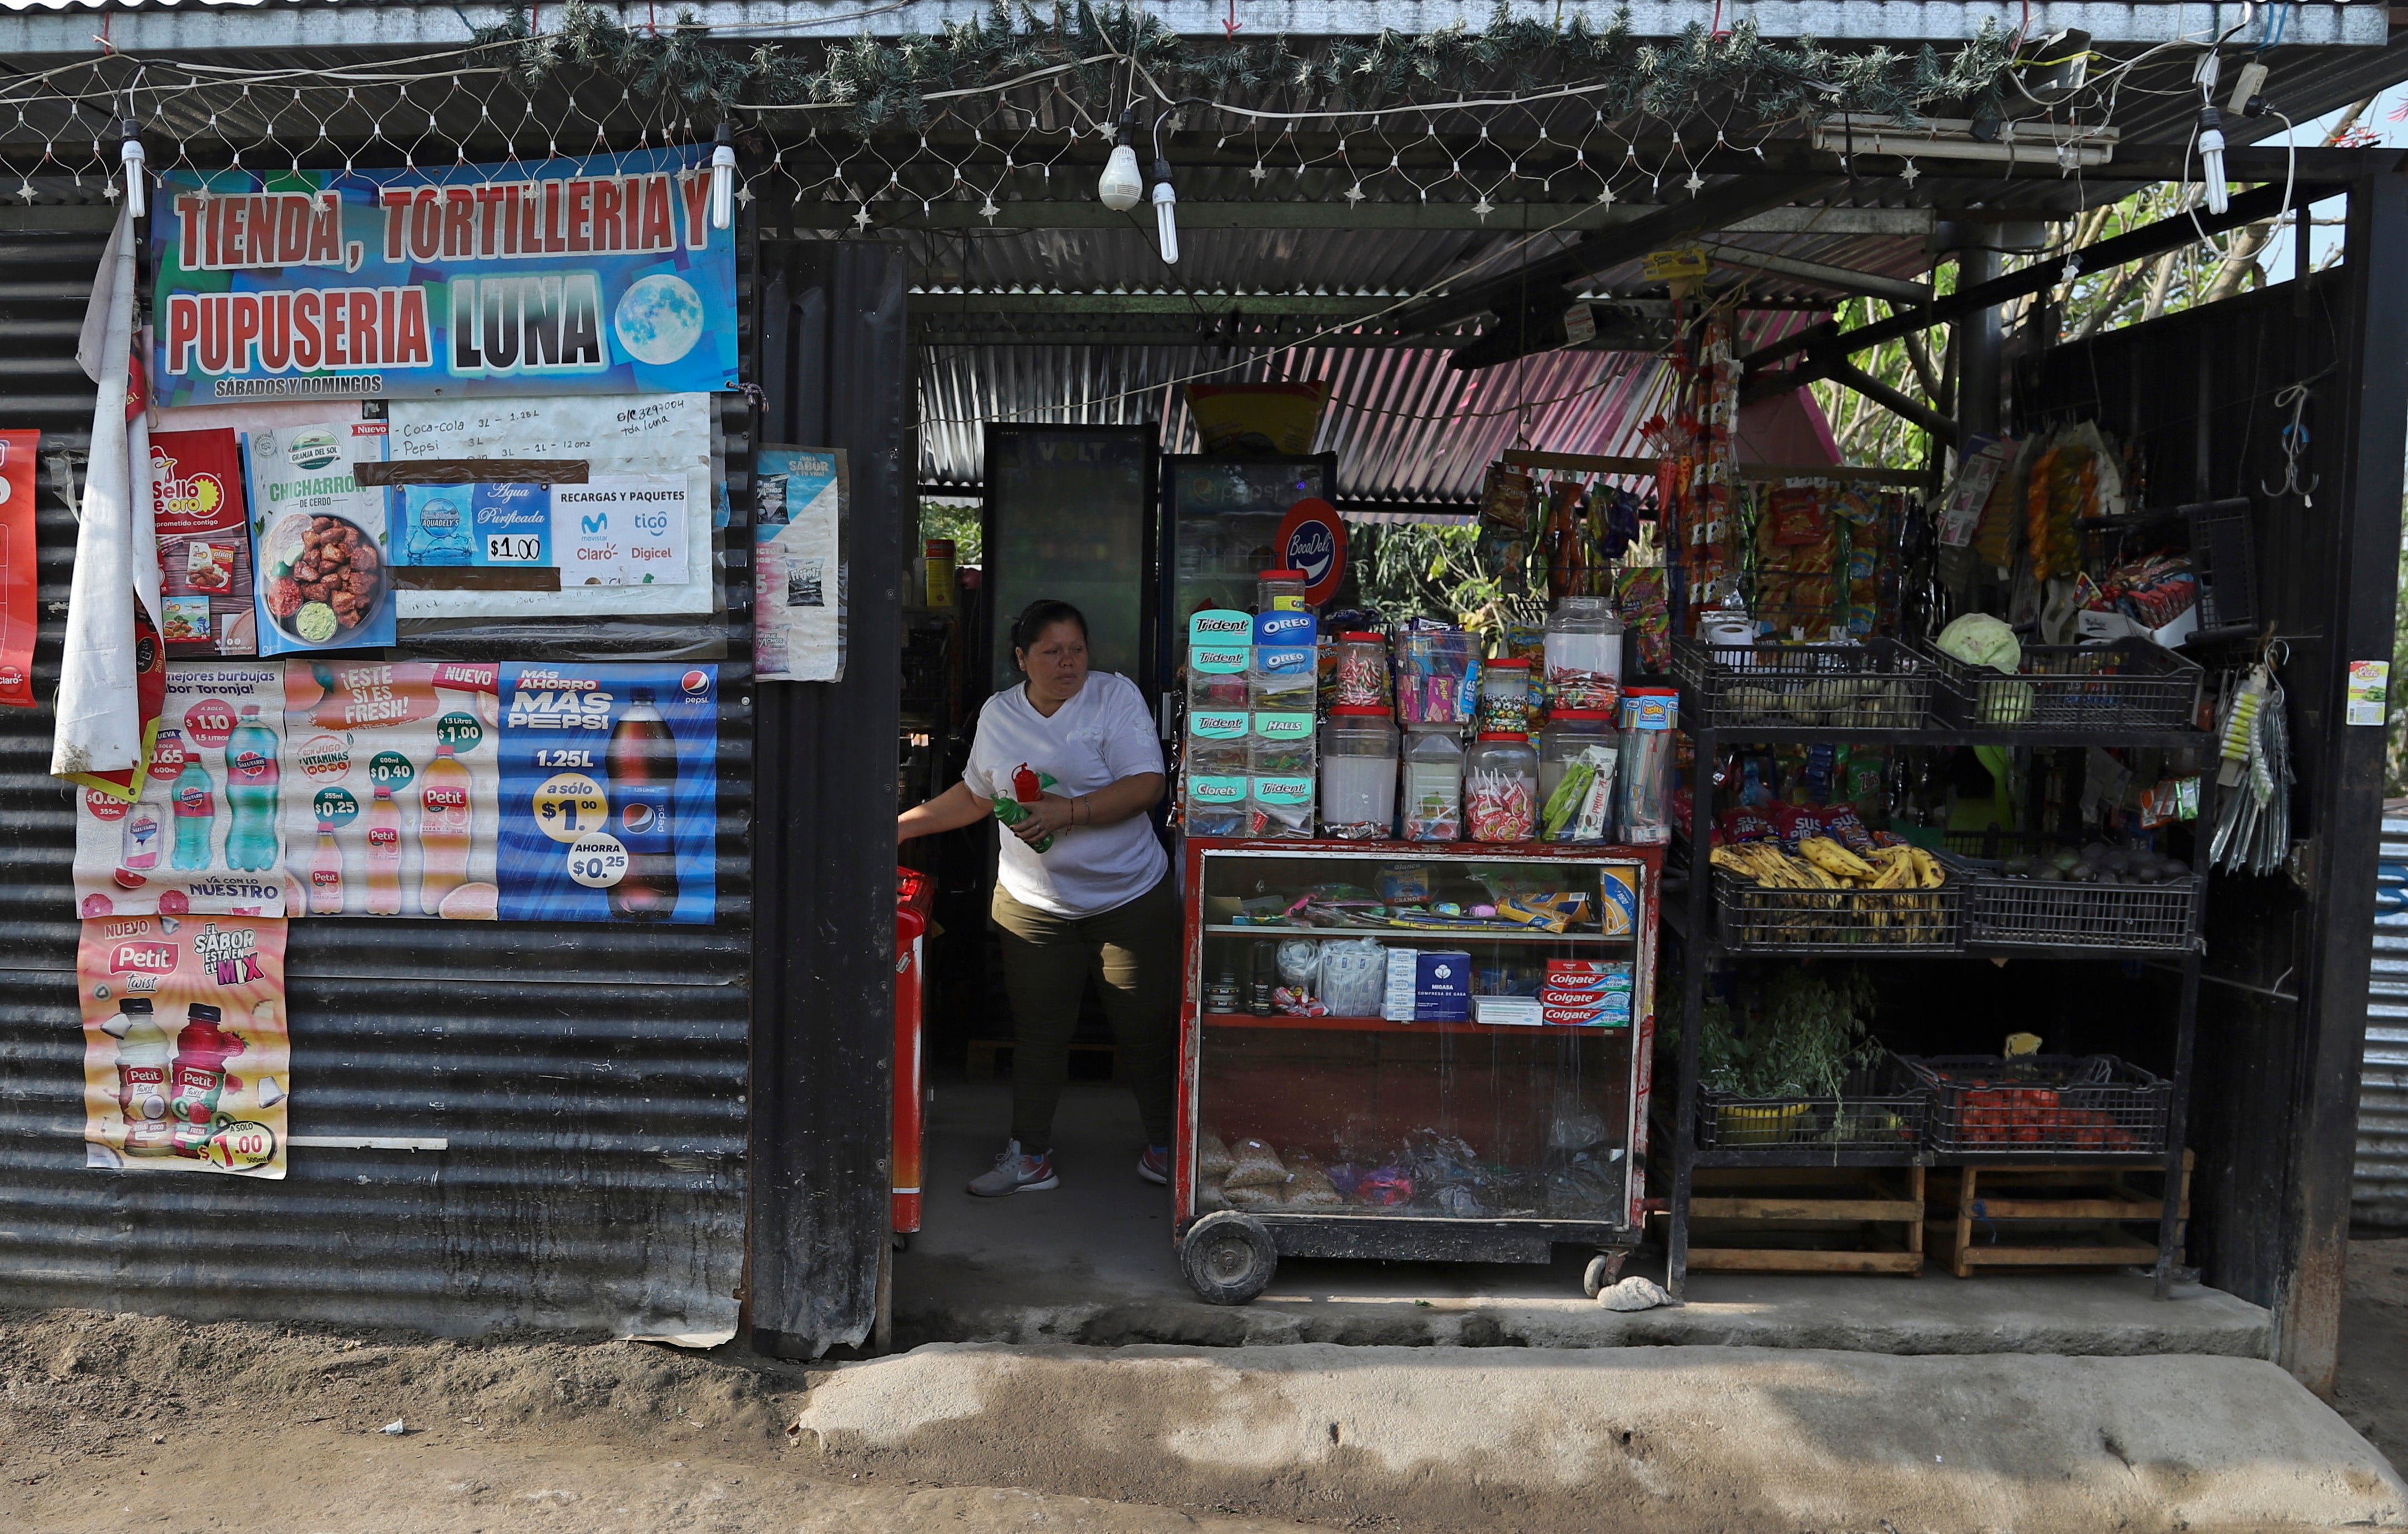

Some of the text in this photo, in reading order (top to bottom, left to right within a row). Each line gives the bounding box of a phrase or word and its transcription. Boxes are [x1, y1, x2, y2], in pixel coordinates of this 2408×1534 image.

[175, 167, 714, 273] TIENDA, TORTILLERIA Y
[165, 273, 606, 376] PUPUSERIA LUNA
[214, 375, 382, 397] SÁBADOS Y DOMINGOS
[357, 425, 387, 434] Nuevo
[403, 438, 439, 456] Pepsi
[1038, 441, 1107, 461] VOLT
[291, 451, 314, 462] GRANJA
[315, 448, 326, 457] DEL
[789, 461, 829, 471] SABOR
[153, 480, 199, 499] Sello
[487, 483, 529, 504] Agua
[299, 497, 331, 508] DE CERDO
[561, 491, 685, 503] RECARGAS Y PAQUETES
[168, 498, 200, 512] oro
[155, 519, 191, 528] prometido
[477, 507, 546, 529] Purificada
[213, 550, 232, 559] alitas
[490, 537, 541, 559] $1.00
[577, 547, 672, 561] Claro Digicel
[1196, 618, 1310, 634] Trident OREO
[1199, 652, 1305, 667] Trident OREO
[165, 671, 275, 684] mejores burbujas
[340, 665, 393, 690] ¡ESTE
[446, 666, 492, 685] NUEVO
[521, 668, 560, 679] MÁS
[199, 684, 254, 697] Toronja!
[519, 679, 598, 690] AHORRO
[1466, 680, 1476, 692] 65
[371, 685, 392, 702] ES
[684, 696, 708, 705] pepsi
[511, 689, 614, 715] MÁS
[1644, 704, 1663, 714] belts
[345, 696, 409, 724] FRESH!
[507, 713, 610, 730] PEPSI
[1198, 717, 1303, 731] Trident HALLS
[158, 731, 176, 739] UEVA
[315, 744, 341, 754] JUGO
[302, 752, 349, 765] VITAMINAS
[536, 749, 594, 768] 1.25L
[547, 782, 593, 795] a sólo
[1197, 782, 1306, 795] Clorets Trident
[427, 790, 462, 804] Petit
[315, 801, 356, 818] $0.25
[656, 804, 666, 833] pepsi
[1795, 817, 1822, 831] SUS
[1831, 814, 1860, 827] SUS
[371, 830, 395, 841] Petit
[574, 844, 621, 853] AHORRA
[206, 875, 221, 884] VA
[314, 873, 337, 882] Petit
[190, 884, 278, 900] NUESTRO
[104, 919, 150, 940] NUEVO
[205, 924, 218, 935] EL
[193, 929, 256, 954] SABOR
[119, 947, 170, 968] Petit
[231, 947, 245, 960] EN
[216, 952, 265, 986] MIX
[126, 973, 158, 990] twist
[1550, 974, 1596, 986] Colgate
[1547, 992, 1593, 1004] Colgate
[1546, 1009, 1591, 1021] Colgate
[130, 1070, 160, 1081] Petit
[184, 1073, 214, 1087] Petit
[189, 1127, 205, 1136] FRESA
[236, 1122, 254, 1132] SOLO
